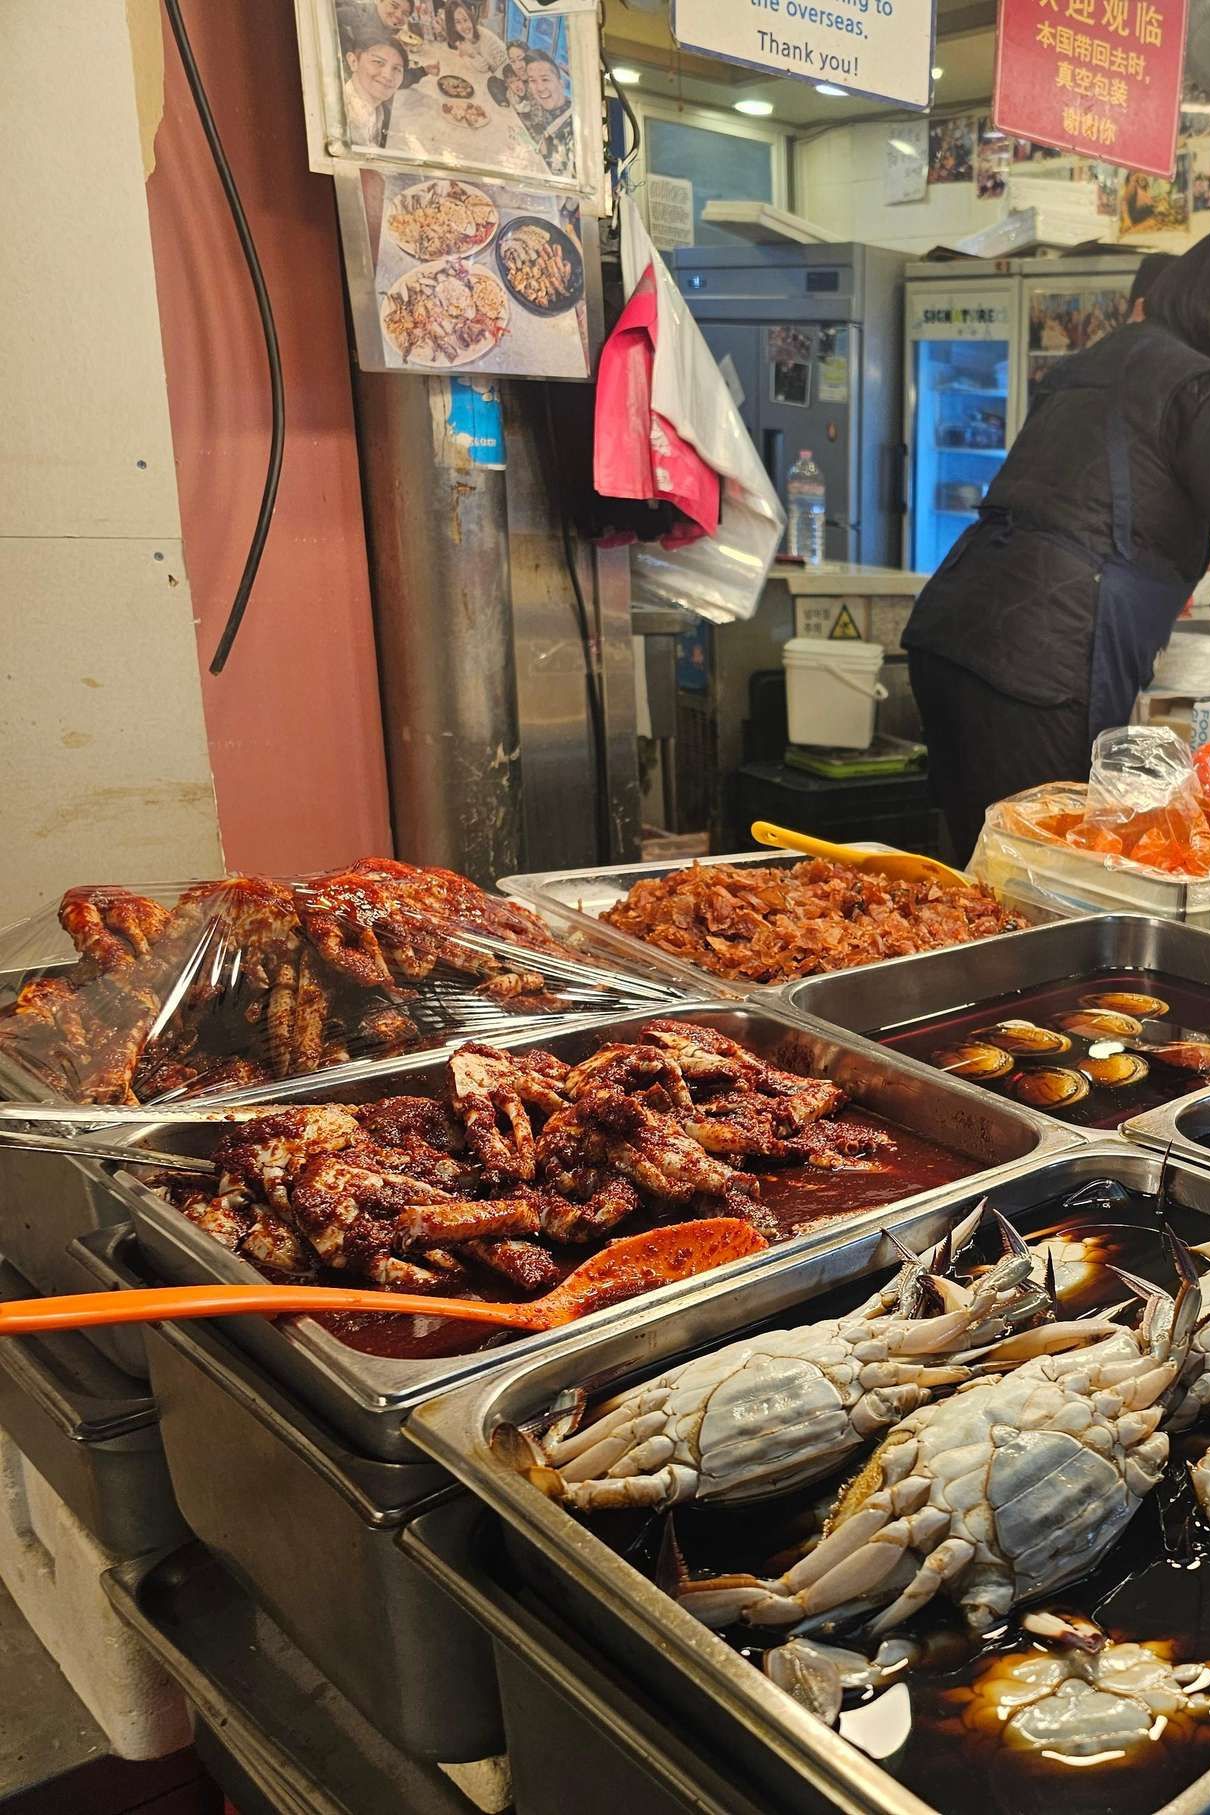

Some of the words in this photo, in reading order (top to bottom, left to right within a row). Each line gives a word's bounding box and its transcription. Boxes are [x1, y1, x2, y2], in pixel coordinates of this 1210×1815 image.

[786, 1, 868, 39] overseas.
[875, 0, 893, 16] to
[1034, 0, 1163, 47] 迎观临
[757, 30, 813, 64] Thank
[819, 56, 859, 76] you!
[1055, 61, 1129, 107] 真空包装
[1062, 105, 1118, 145] 谢谢你
[1199, 710, 1209, 744] FOO
